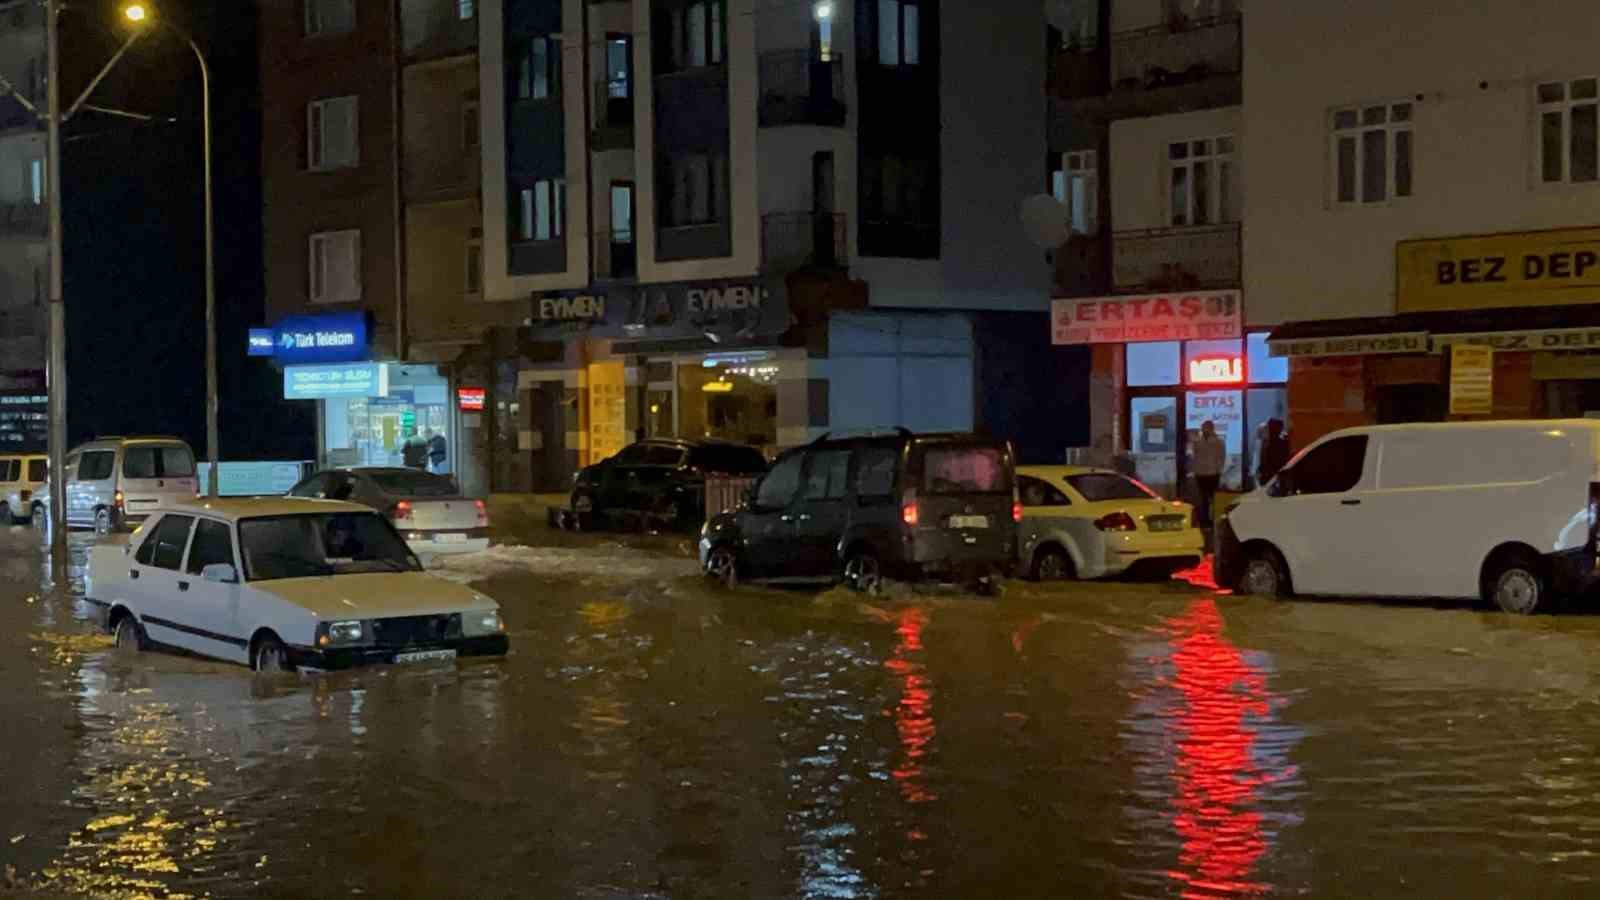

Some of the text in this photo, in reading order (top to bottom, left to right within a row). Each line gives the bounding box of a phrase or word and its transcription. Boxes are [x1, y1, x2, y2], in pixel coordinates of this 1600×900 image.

[1437, 251, 1597, 285] BEZ DEP
[540, 296, 604, 320] EYMEN
[688, 286, 761, 313] EYMEN
[294, 331, 354, 348] Türk Telekom
[1325, 337, 1418, 353] DEPOSU
